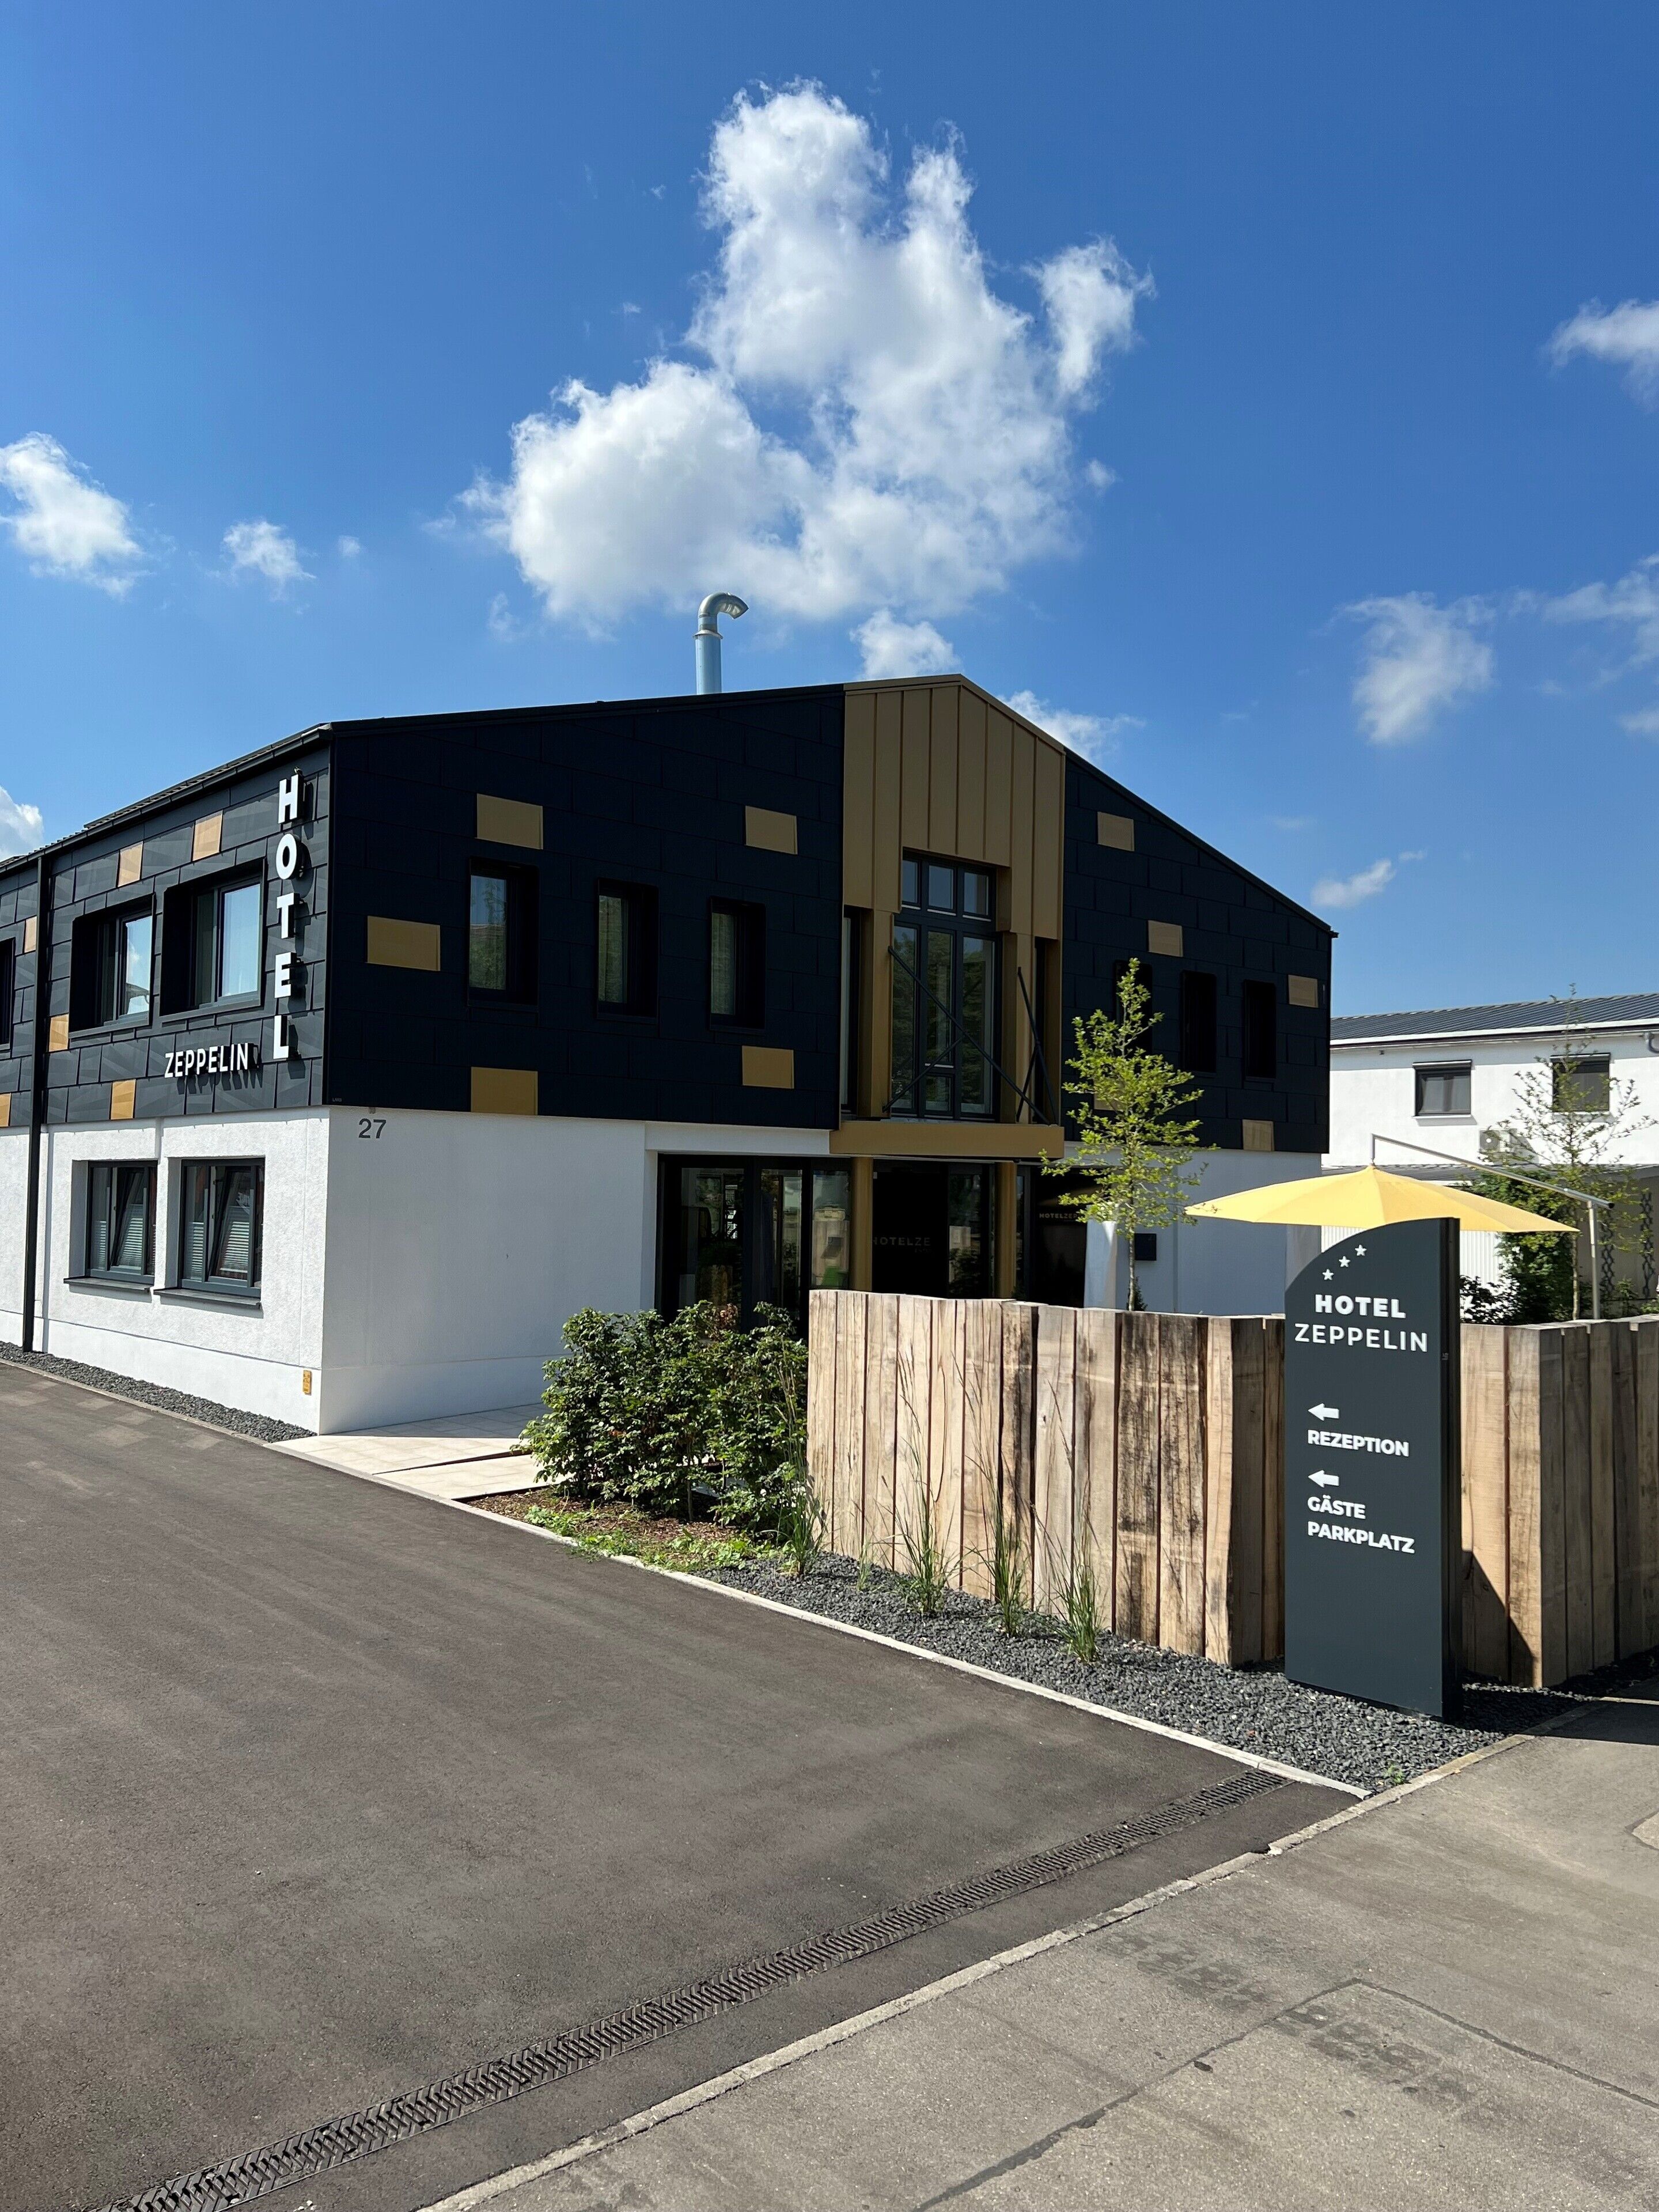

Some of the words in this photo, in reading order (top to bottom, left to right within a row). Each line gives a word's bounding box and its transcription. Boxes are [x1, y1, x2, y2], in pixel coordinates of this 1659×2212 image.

[273, 774, 299, 1059] HOTEL
[165, 1043, 248, 1078] ZEPPELIN
[358, 1118, 387, 1139] 27
[1315, 1294, 1406, 1319] HOTEL
[1294, 1323, 1427, 1352] ZEPPELIN
[1308, 1429, 1410, 1457] REZEPTION
[1307, 1494, 1366, 1520] GÄSTE
[1308, 1521, 1415, 1554] PARKPLATZ
